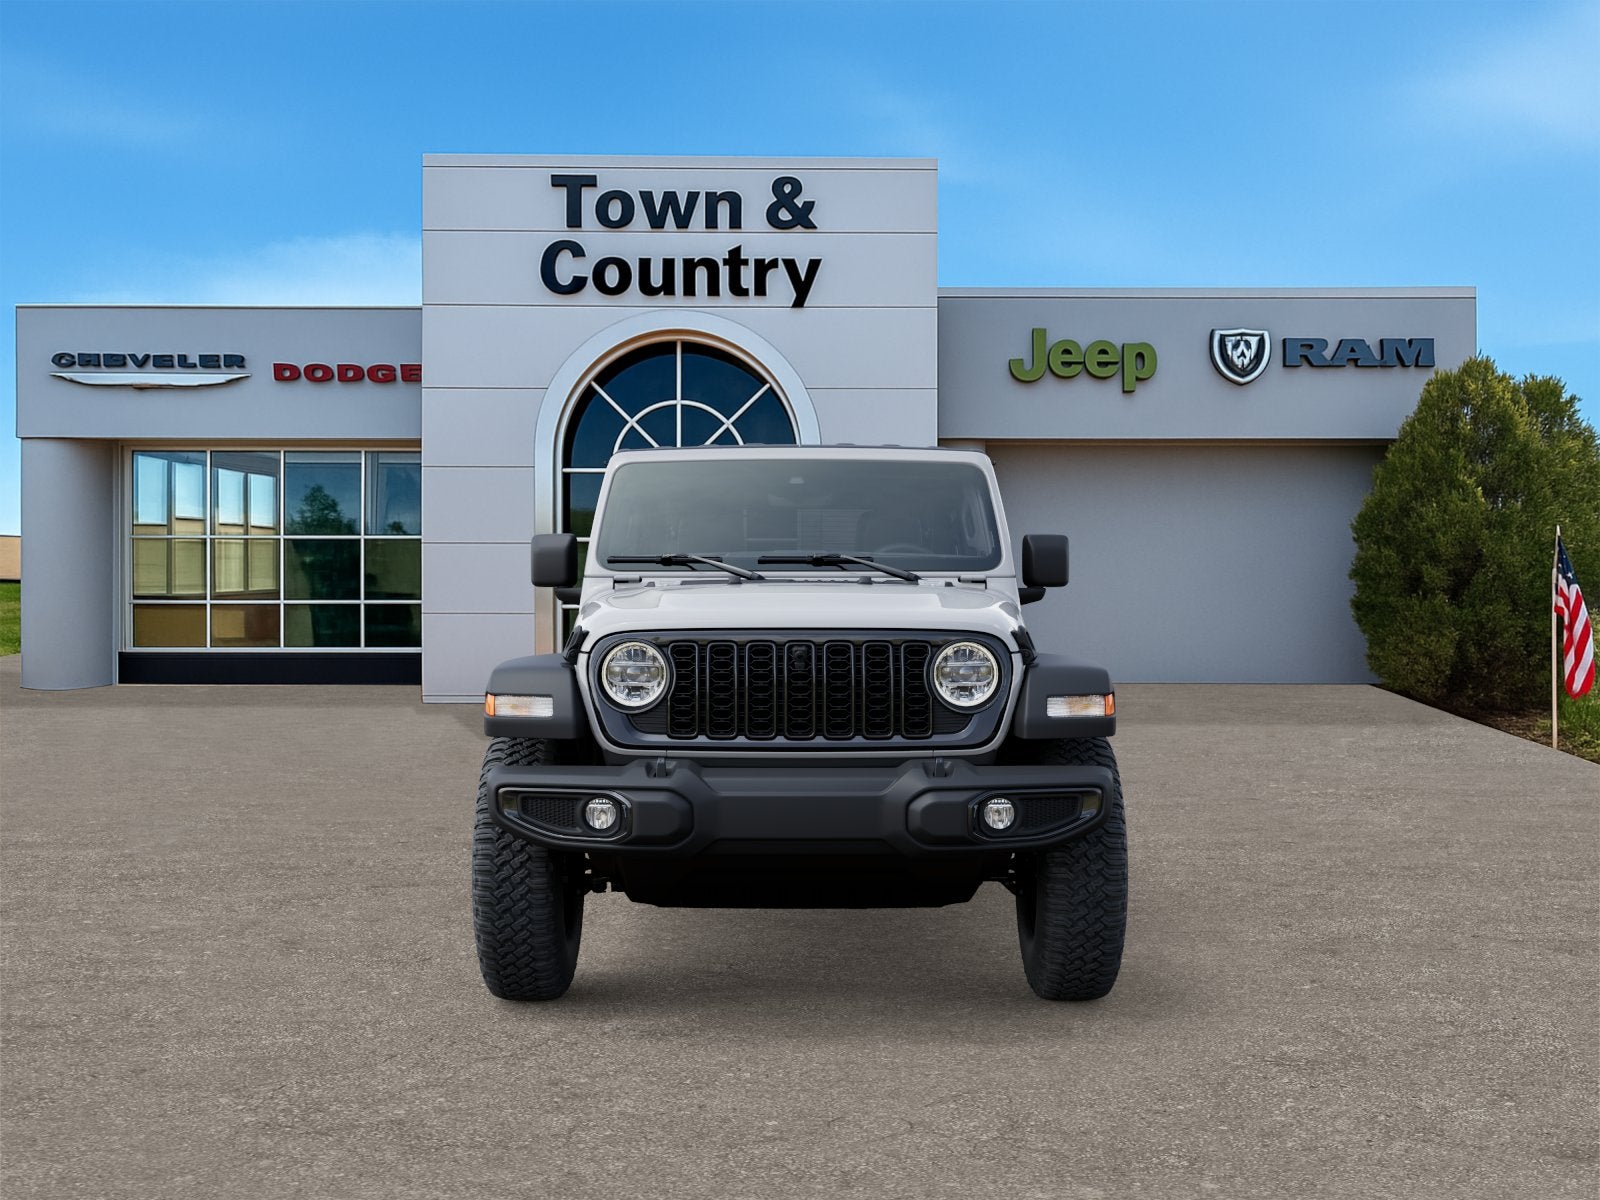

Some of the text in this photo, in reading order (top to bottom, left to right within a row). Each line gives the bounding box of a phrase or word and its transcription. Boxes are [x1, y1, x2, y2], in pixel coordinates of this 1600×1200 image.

[551, 174, 818, 230] Town &
[540, 239, 823, 308] Country
[273, 362, 422, 383] DODGE
[1009, 328, 1157, 392] Jeep
[1283, 337, 1435, 367] RAM
